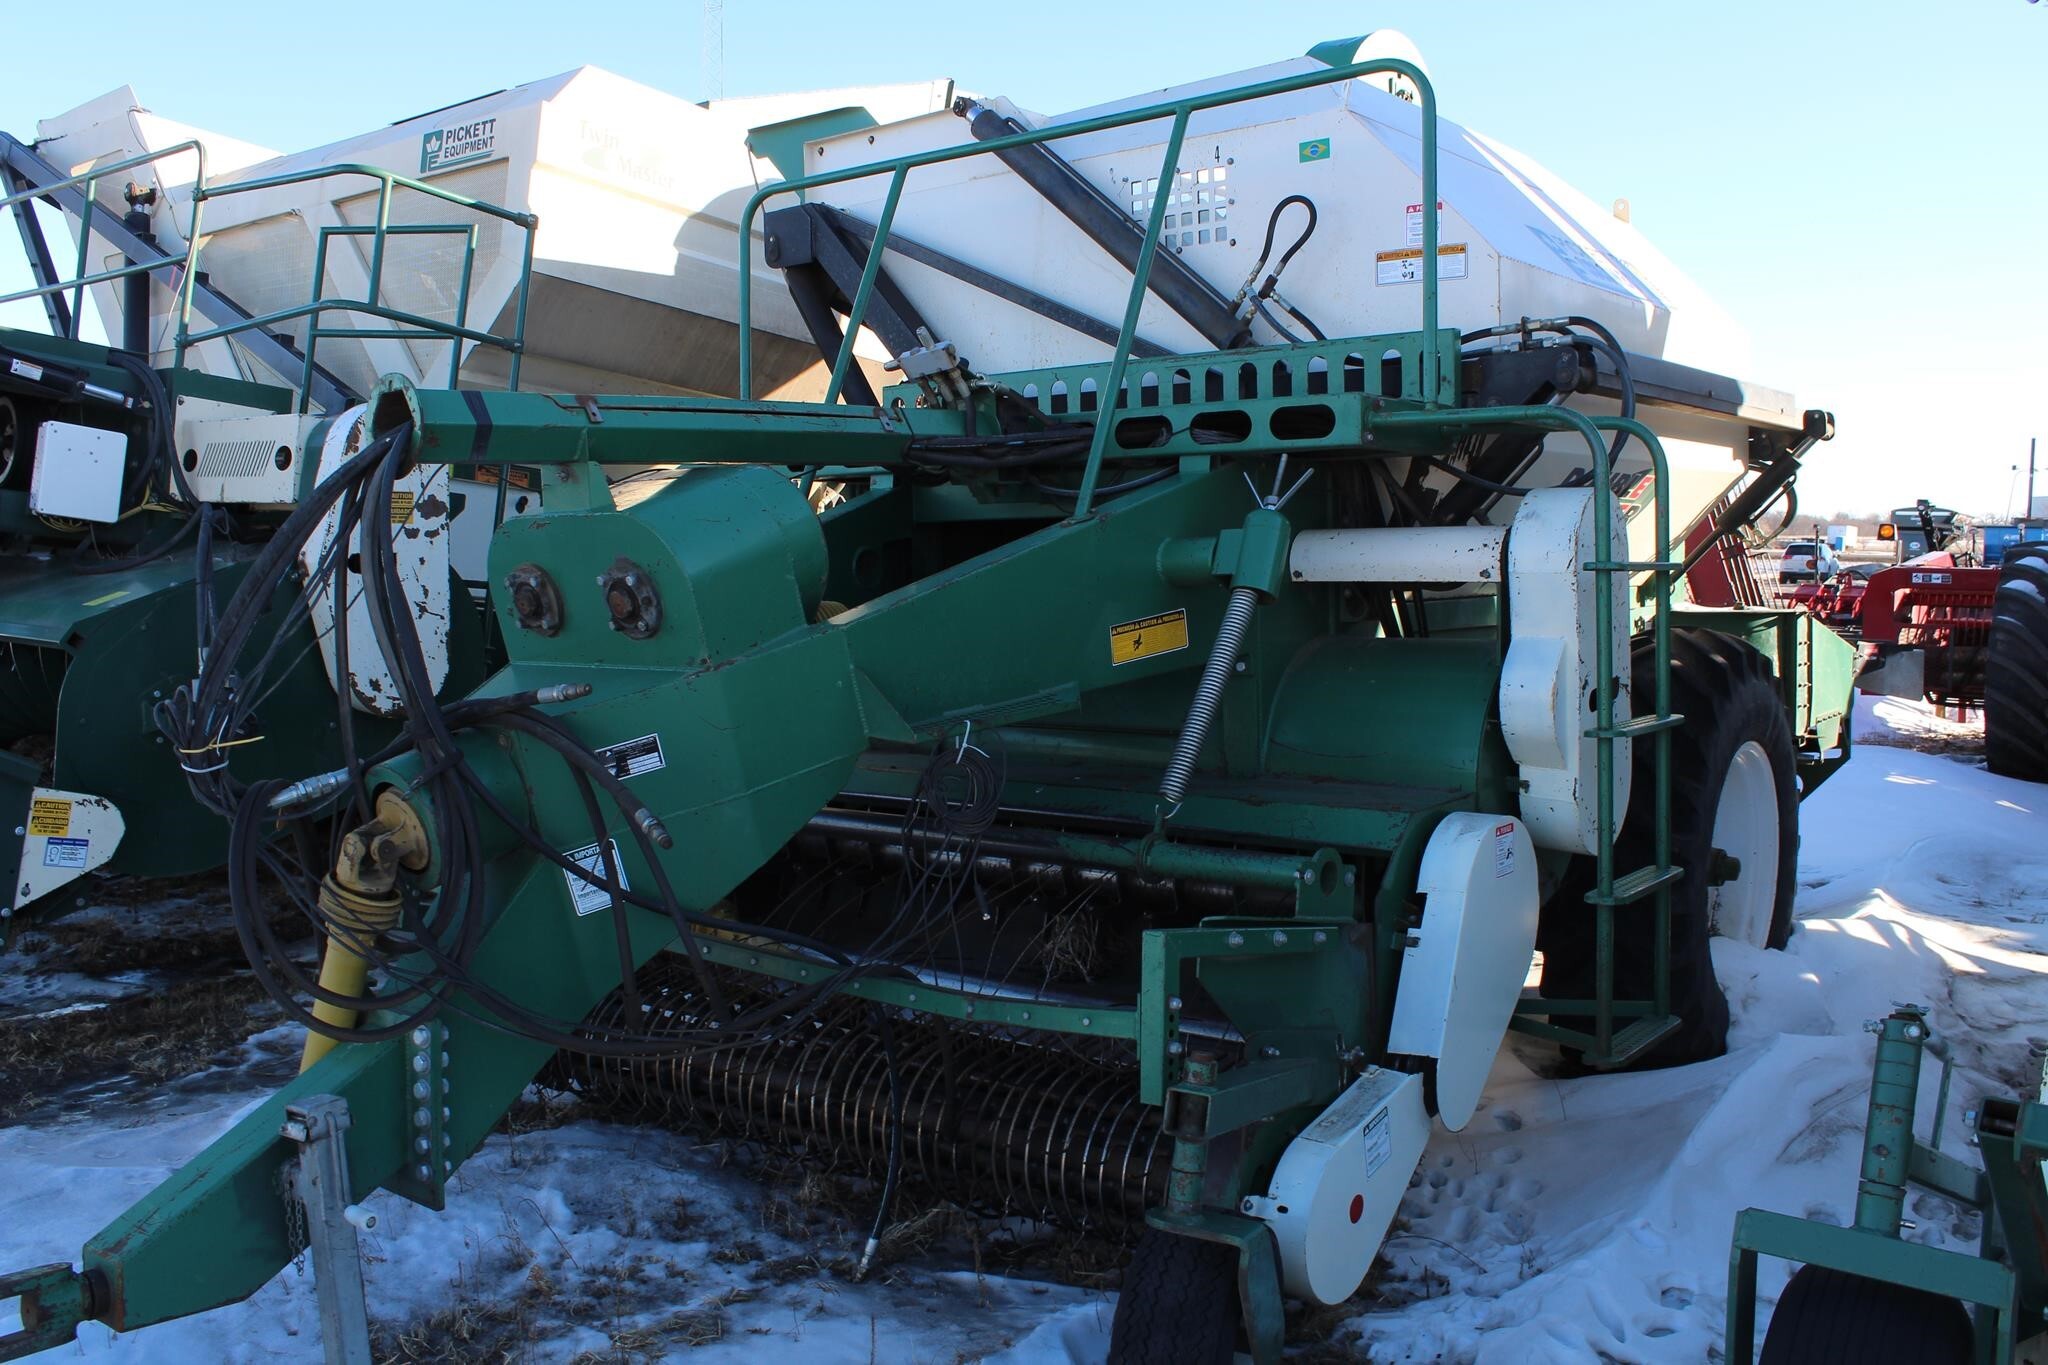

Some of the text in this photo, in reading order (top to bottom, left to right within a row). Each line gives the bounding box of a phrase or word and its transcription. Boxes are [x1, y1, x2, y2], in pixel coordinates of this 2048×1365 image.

[446, 118, 496, 145] PICKETT
[444, 136, 495, 159] EQUIPMENT
[41, 801, 71, 810] CAUTION
[574, 845, 600, 860] IMPORTA
